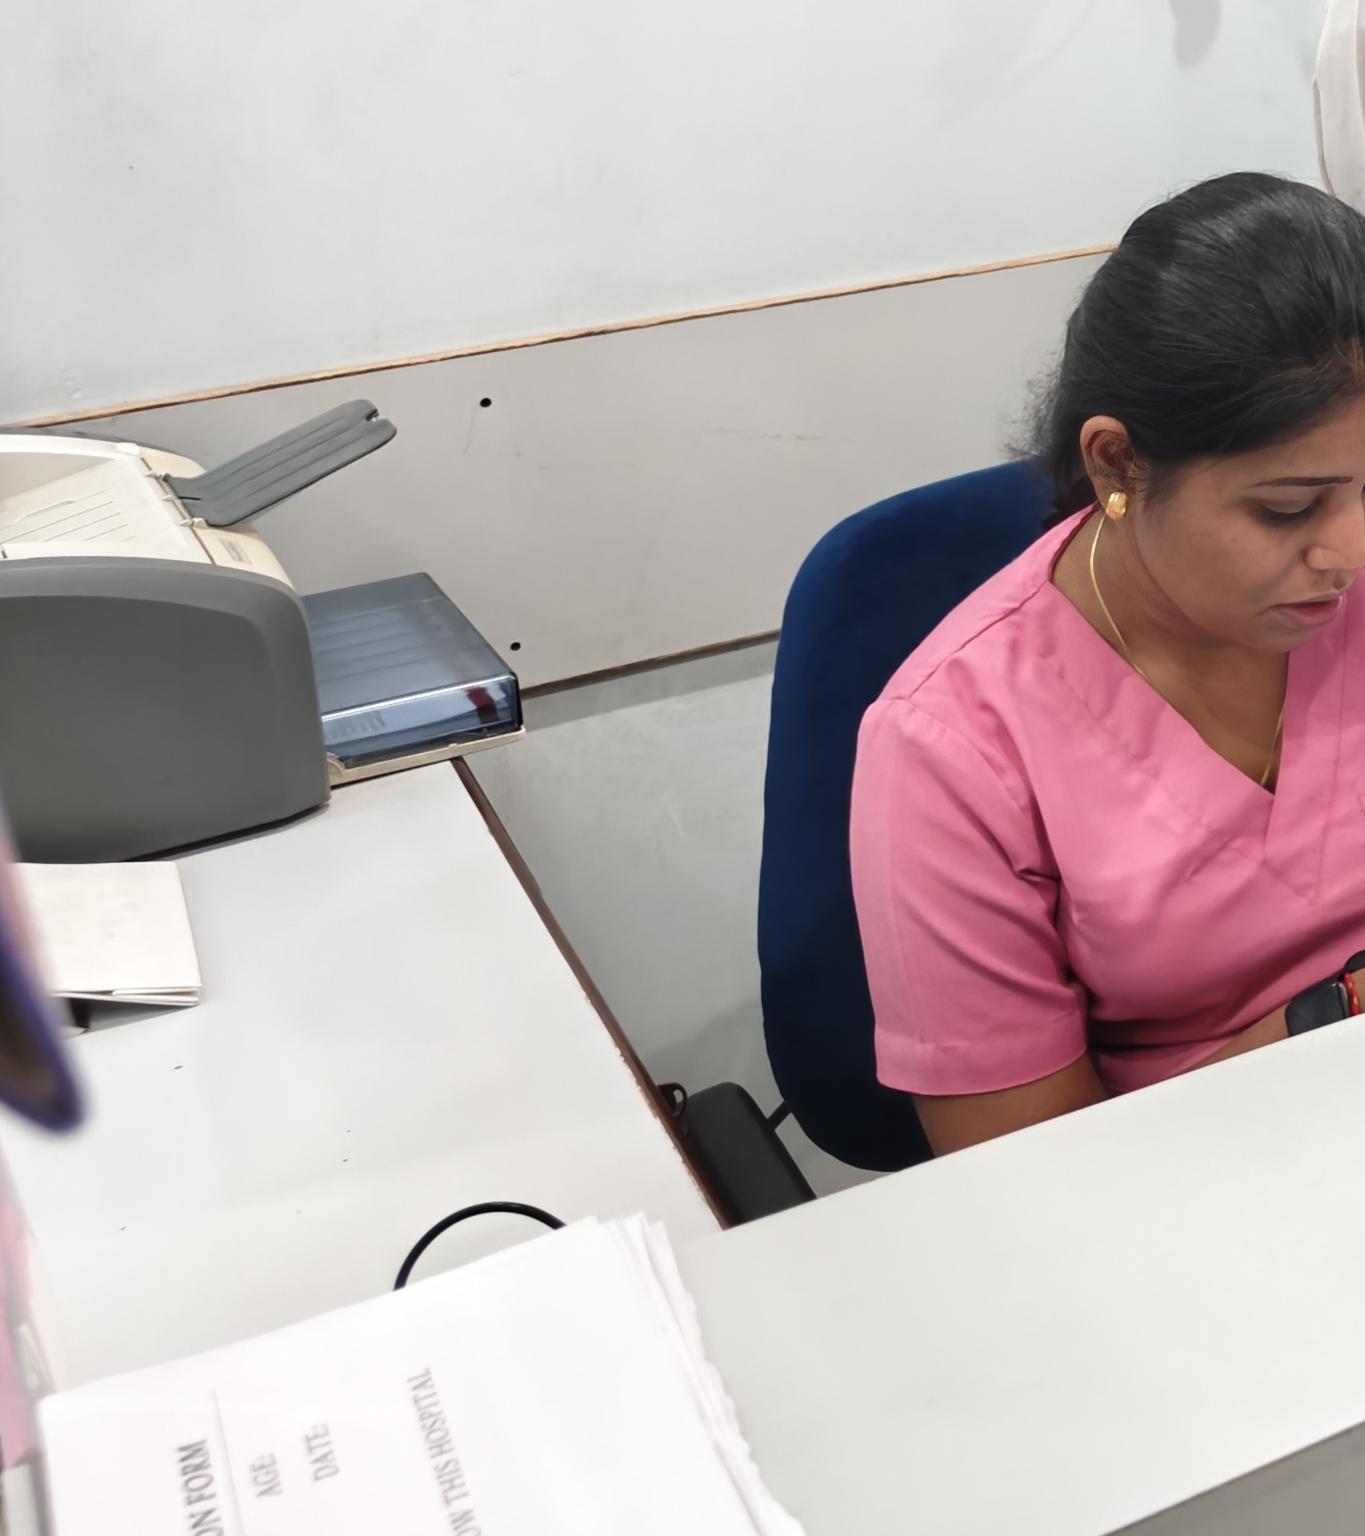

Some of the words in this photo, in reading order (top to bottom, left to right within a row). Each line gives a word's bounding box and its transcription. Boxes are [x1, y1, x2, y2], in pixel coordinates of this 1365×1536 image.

[406, 1365, 456, 1460] HOSPITAL
[176, 1438, 217, 1507] FORM
[250, 1452, 283, 1499] AGE:
[304, 1421, 341, 1483] DATE:
[432, 1457, 469, 1508] THIS
